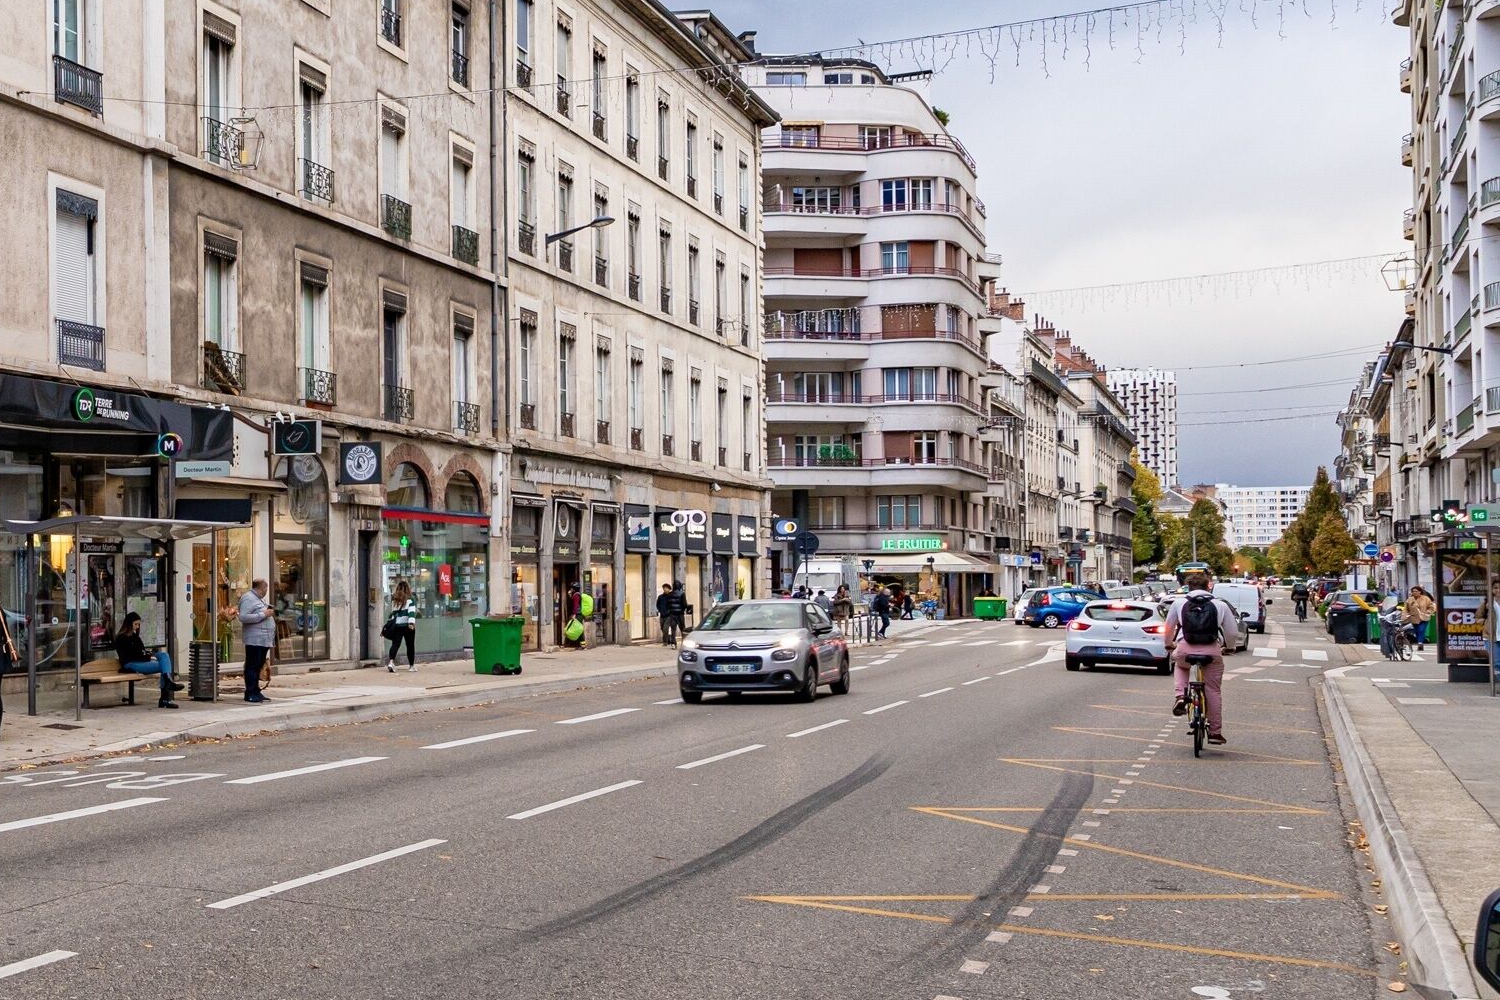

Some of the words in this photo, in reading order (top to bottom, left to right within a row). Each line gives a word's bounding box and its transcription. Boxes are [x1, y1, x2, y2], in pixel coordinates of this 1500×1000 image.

[79, 399, 92, 412] TDR
[94, 397, 113, 409] TERRE
[102, 408, 129, 420] RUNNING
[164, 440, 174, 451] M
[83, 543, 102, 552] Docteur
[102, 543, 117, 552] Martin
[882, 539, 895, 550] LE
[897, 539, 941, 550] FRUITIER
